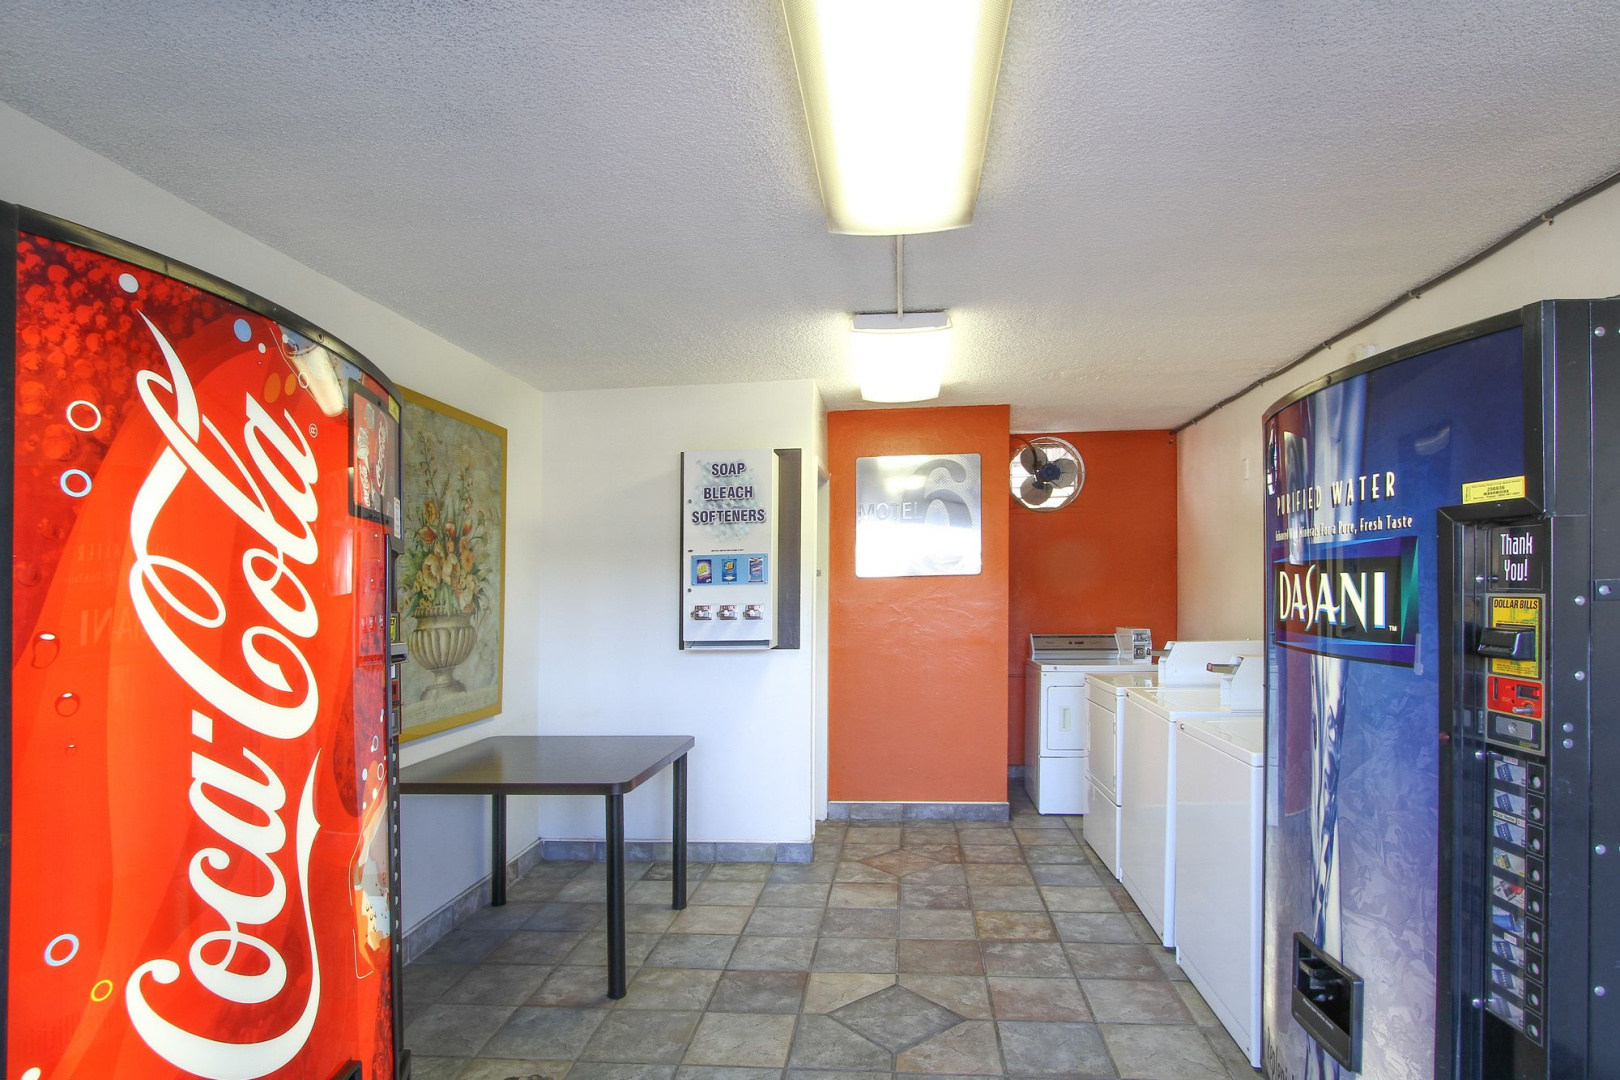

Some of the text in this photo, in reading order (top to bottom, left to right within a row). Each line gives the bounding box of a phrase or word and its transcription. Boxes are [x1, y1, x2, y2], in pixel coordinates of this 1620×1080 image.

[711, 462, 746, 476] SOAP
[703, 486, 753, 500] BLEACH
[1276, 471, 1395, 516] PURIFIED WATER
[692, 509, 765, 524] SOFTENERS
[858, 458, 973, 571] MOTEL 6
[1338, 520, 1357, 534] Pure,
[1360, 516, 1383, 532] Fresh
[1386, 514, 1413, 529] Taste
[1500, 532, 1533, 555] Thank
[1504, 559, 1528, 581] You!
[1279, 564, 1386, 633] DASANI
[1494, 599, 1538, 609] DOLLAR BILLS
[126, 310, 321, 1079] Coca-Cola
